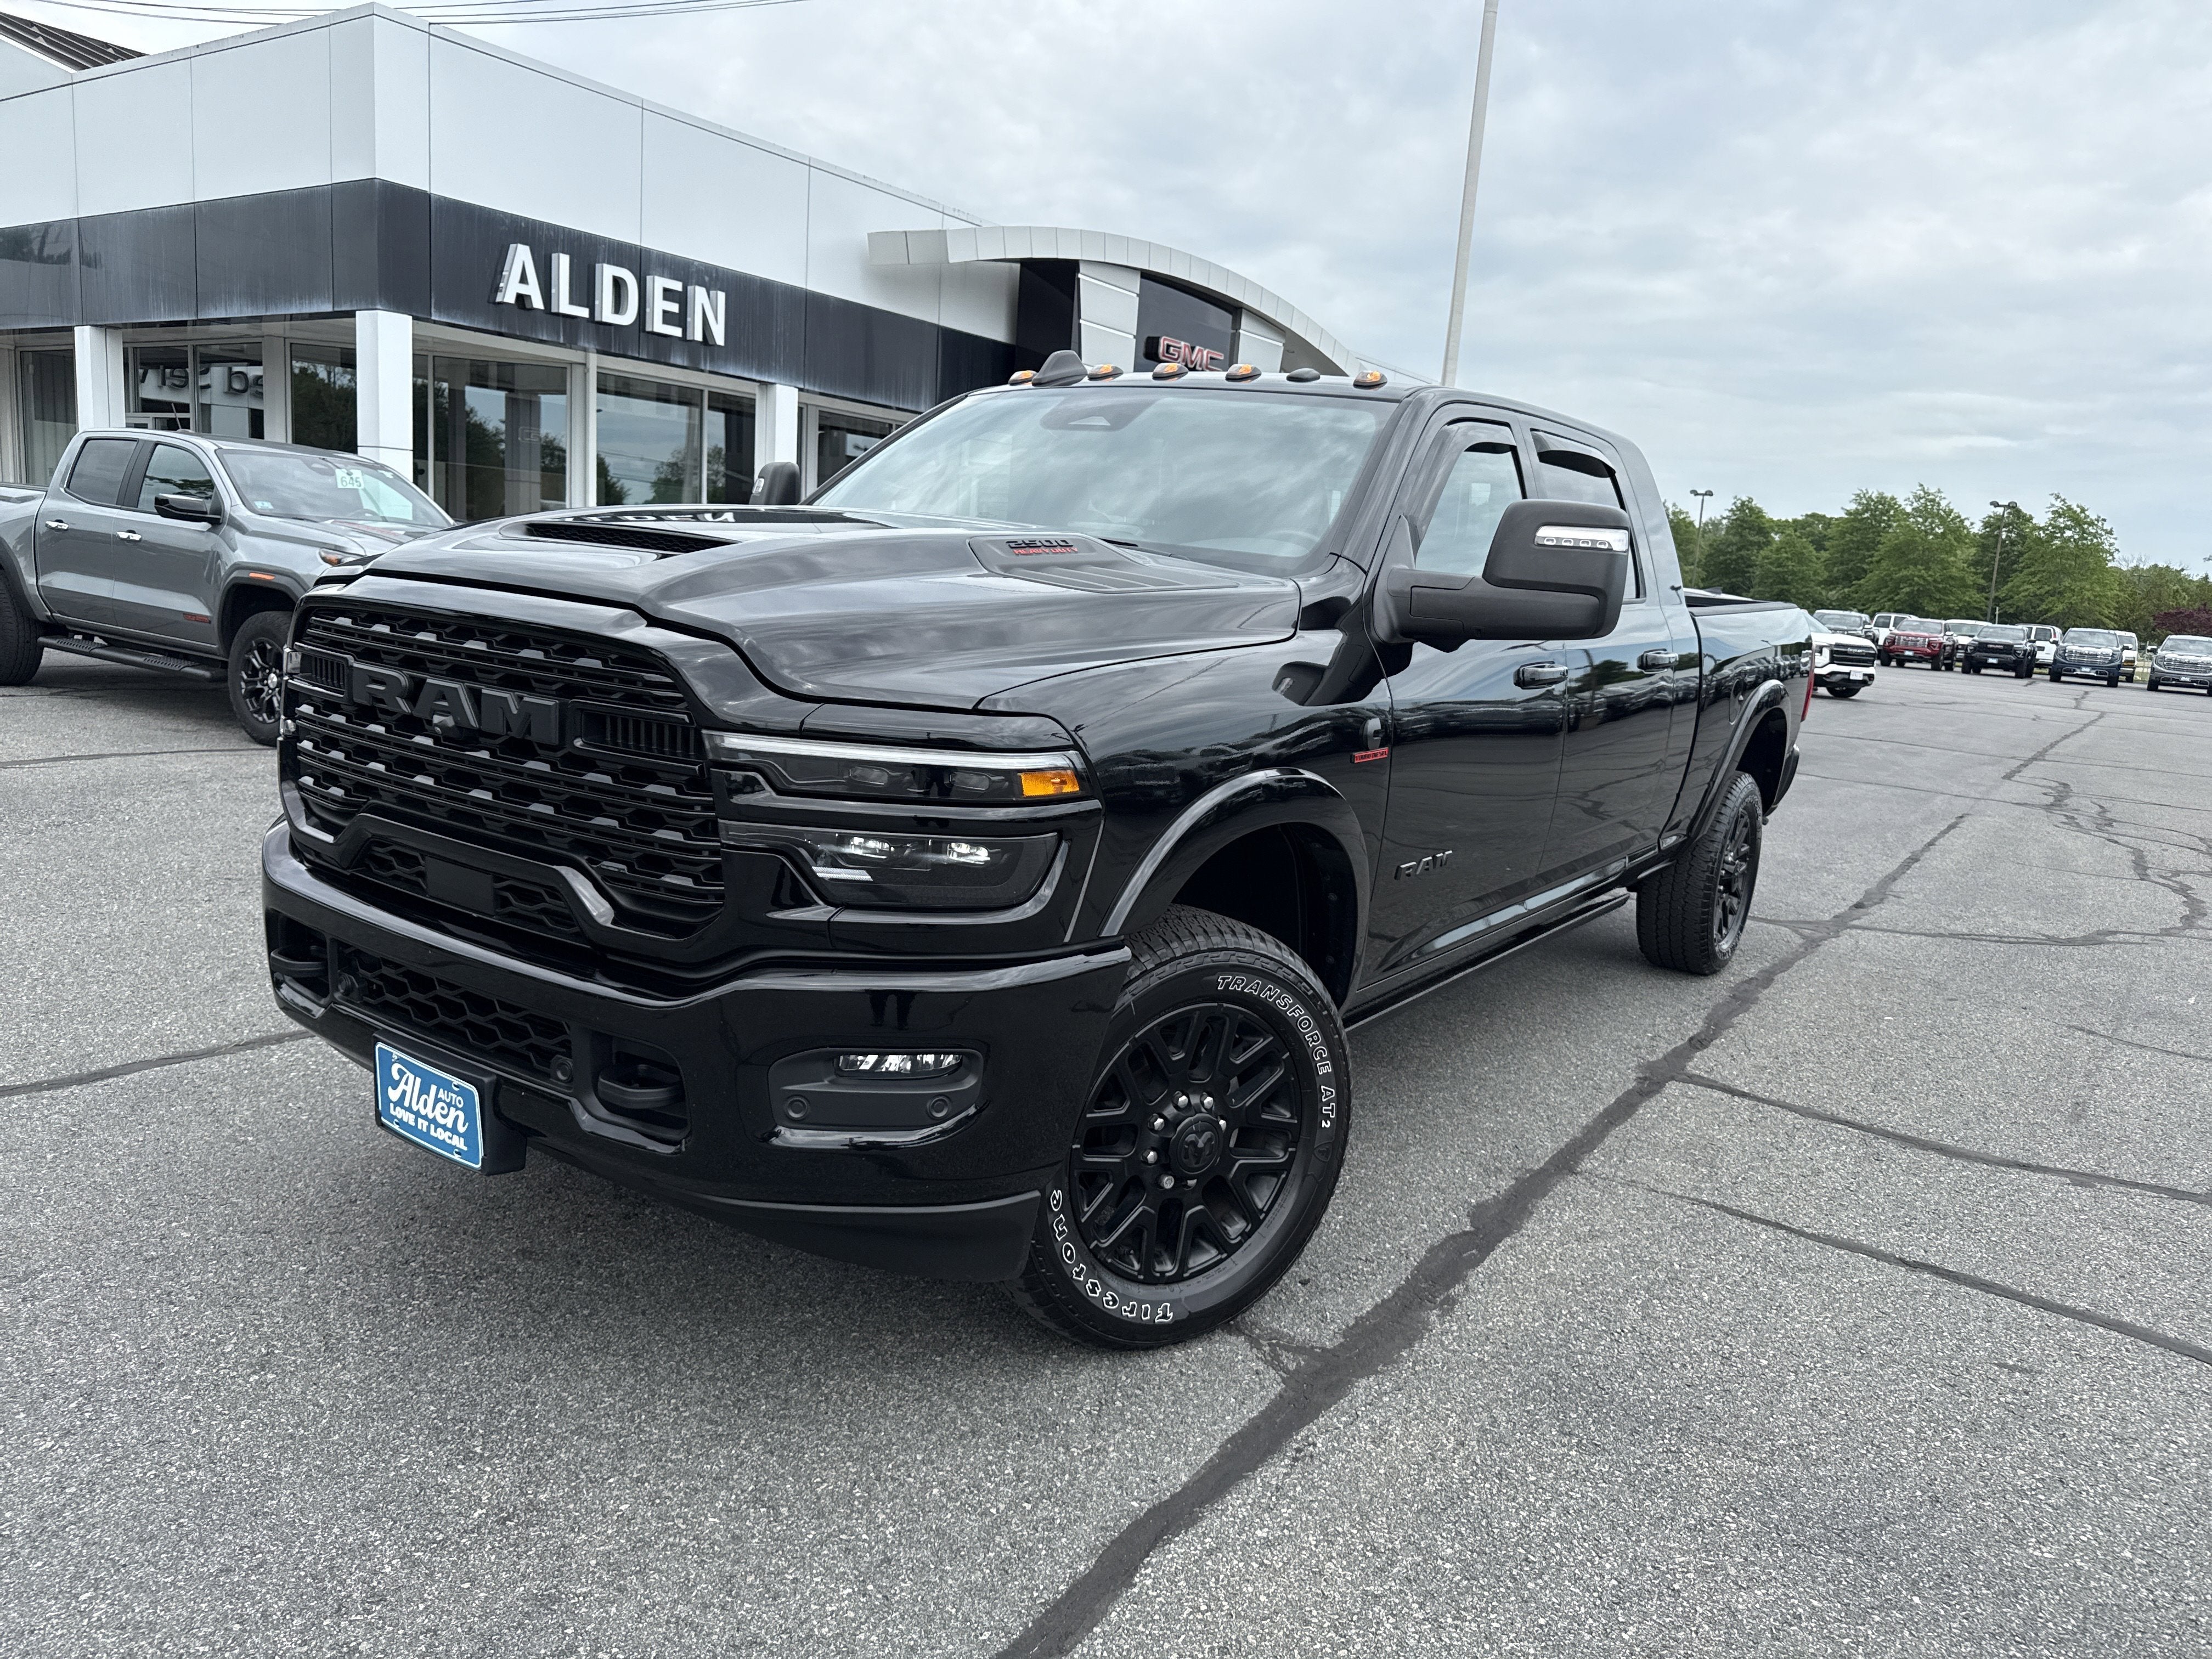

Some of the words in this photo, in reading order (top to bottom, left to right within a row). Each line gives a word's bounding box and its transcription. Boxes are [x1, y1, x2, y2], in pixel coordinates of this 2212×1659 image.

[496, 243, 726, 346] ALDEN
[1159, 336, 1224, 371] GMC
[341, 476, 362, 487] 645
[1006, 539, 1074, 549] 2500
[352, 663, 559, 746] RAM
[1394, 850, 1453, 881] RAM
[1217, 975, 1331, 1075] TRANSFORCE
[387, 1063, 469, 1132] Alden
[438, 1088, 464, 1108] AUTO
[390, 1102, 415, 1127] LOVE
[417, 1118, 428, 1132] IT
[430, 1125, 467, 1151] LOCAL
[1049, 1189, 1173, 1323] Firestone
